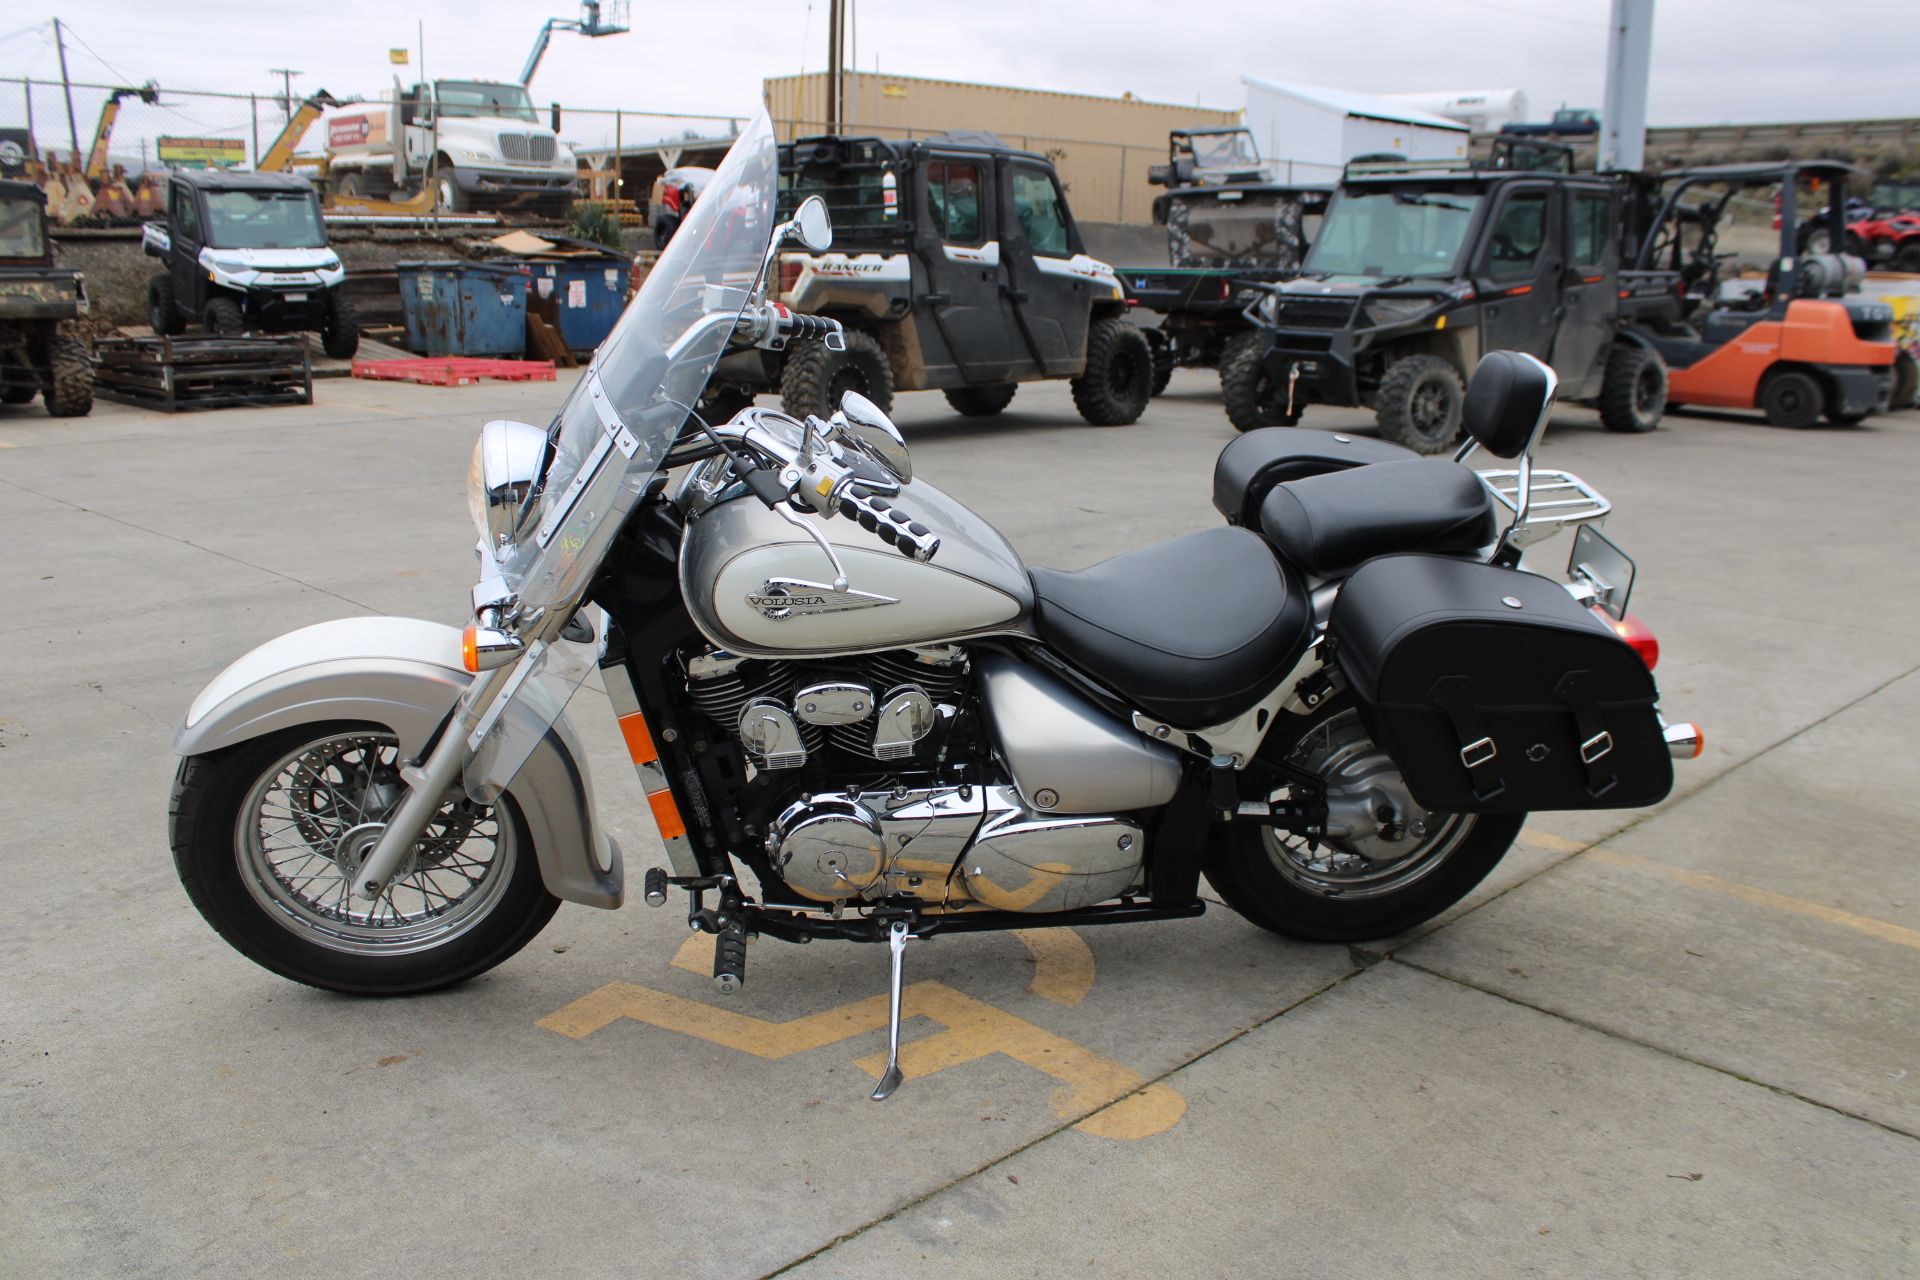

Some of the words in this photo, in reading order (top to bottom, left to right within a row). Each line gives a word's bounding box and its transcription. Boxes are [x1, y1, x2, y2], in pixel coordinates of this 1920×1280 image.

[822, 263, 882, 272] RANGER
[750, 596, 826, 606] VOLUSIA
[763, 611, 793, 620] SUZUKI
